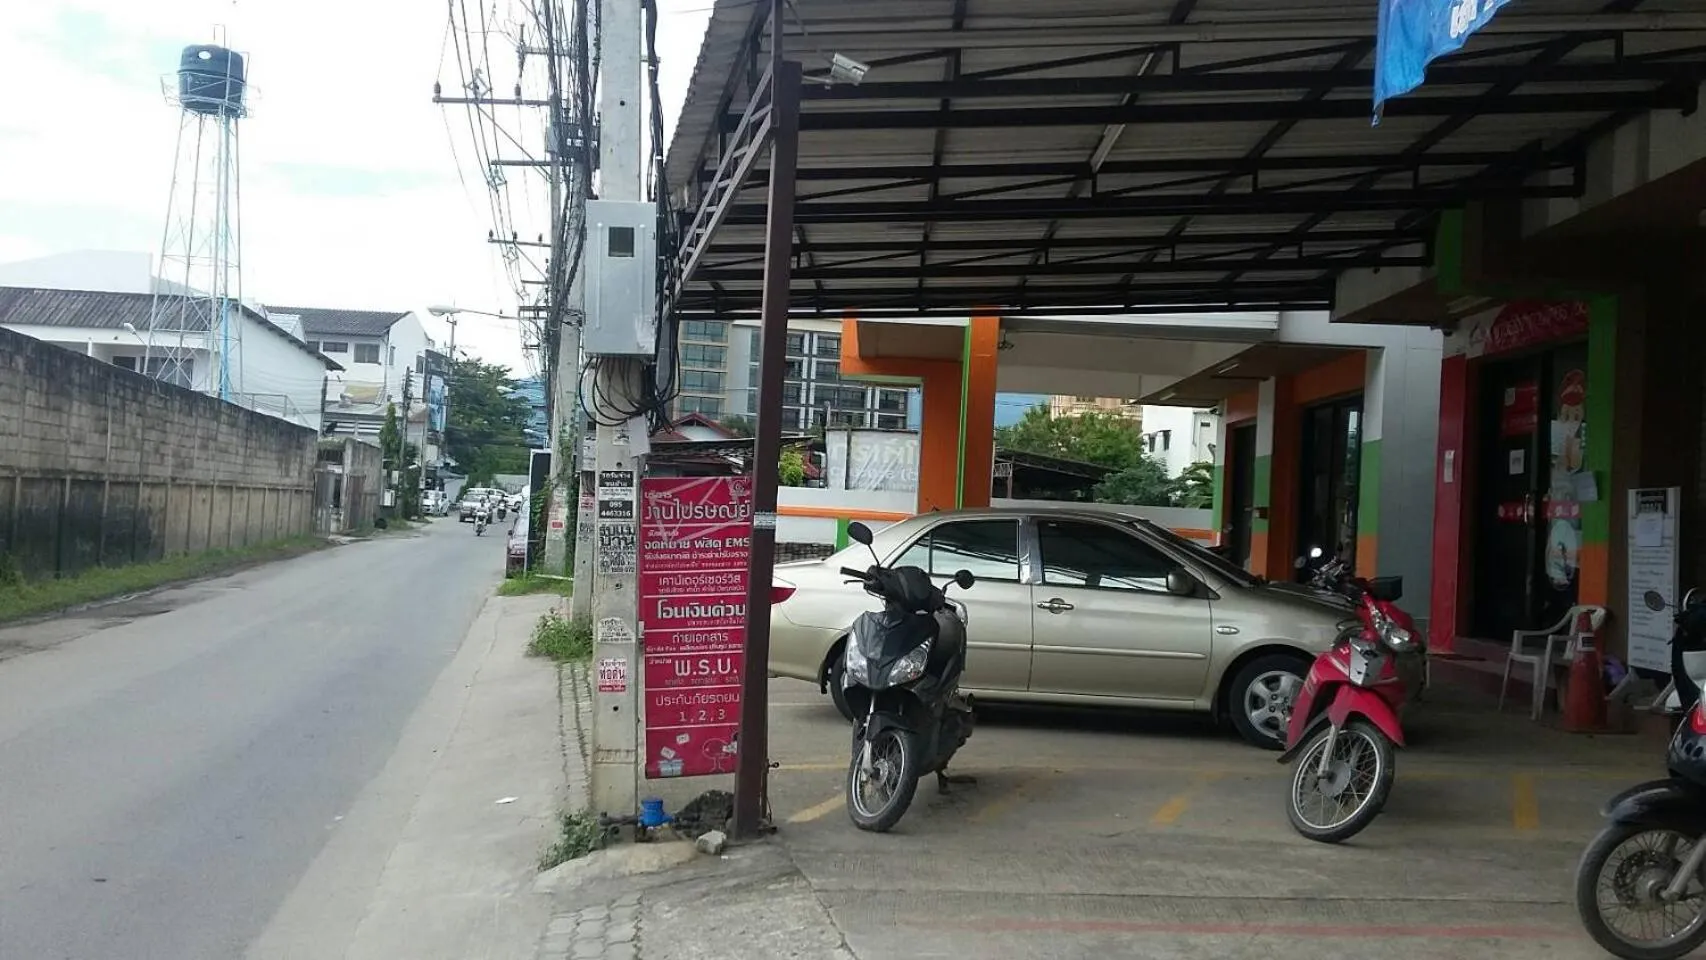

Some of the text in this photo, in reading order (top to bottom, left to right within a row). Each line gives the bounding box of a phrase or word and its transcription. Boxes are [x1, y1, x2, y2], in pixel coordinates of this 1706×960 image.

[644, 498, 751, 520] งานไปรษณีย์
[644, 537, 751, 551] จดหมาย พัสดุ EMS
[657, 599, 746, 619] โอนเงินด่วน
[672, 632, 729, 644] ถ่ายเอกสาร
[675, 657, 738, 677] พ.ร.บ.
